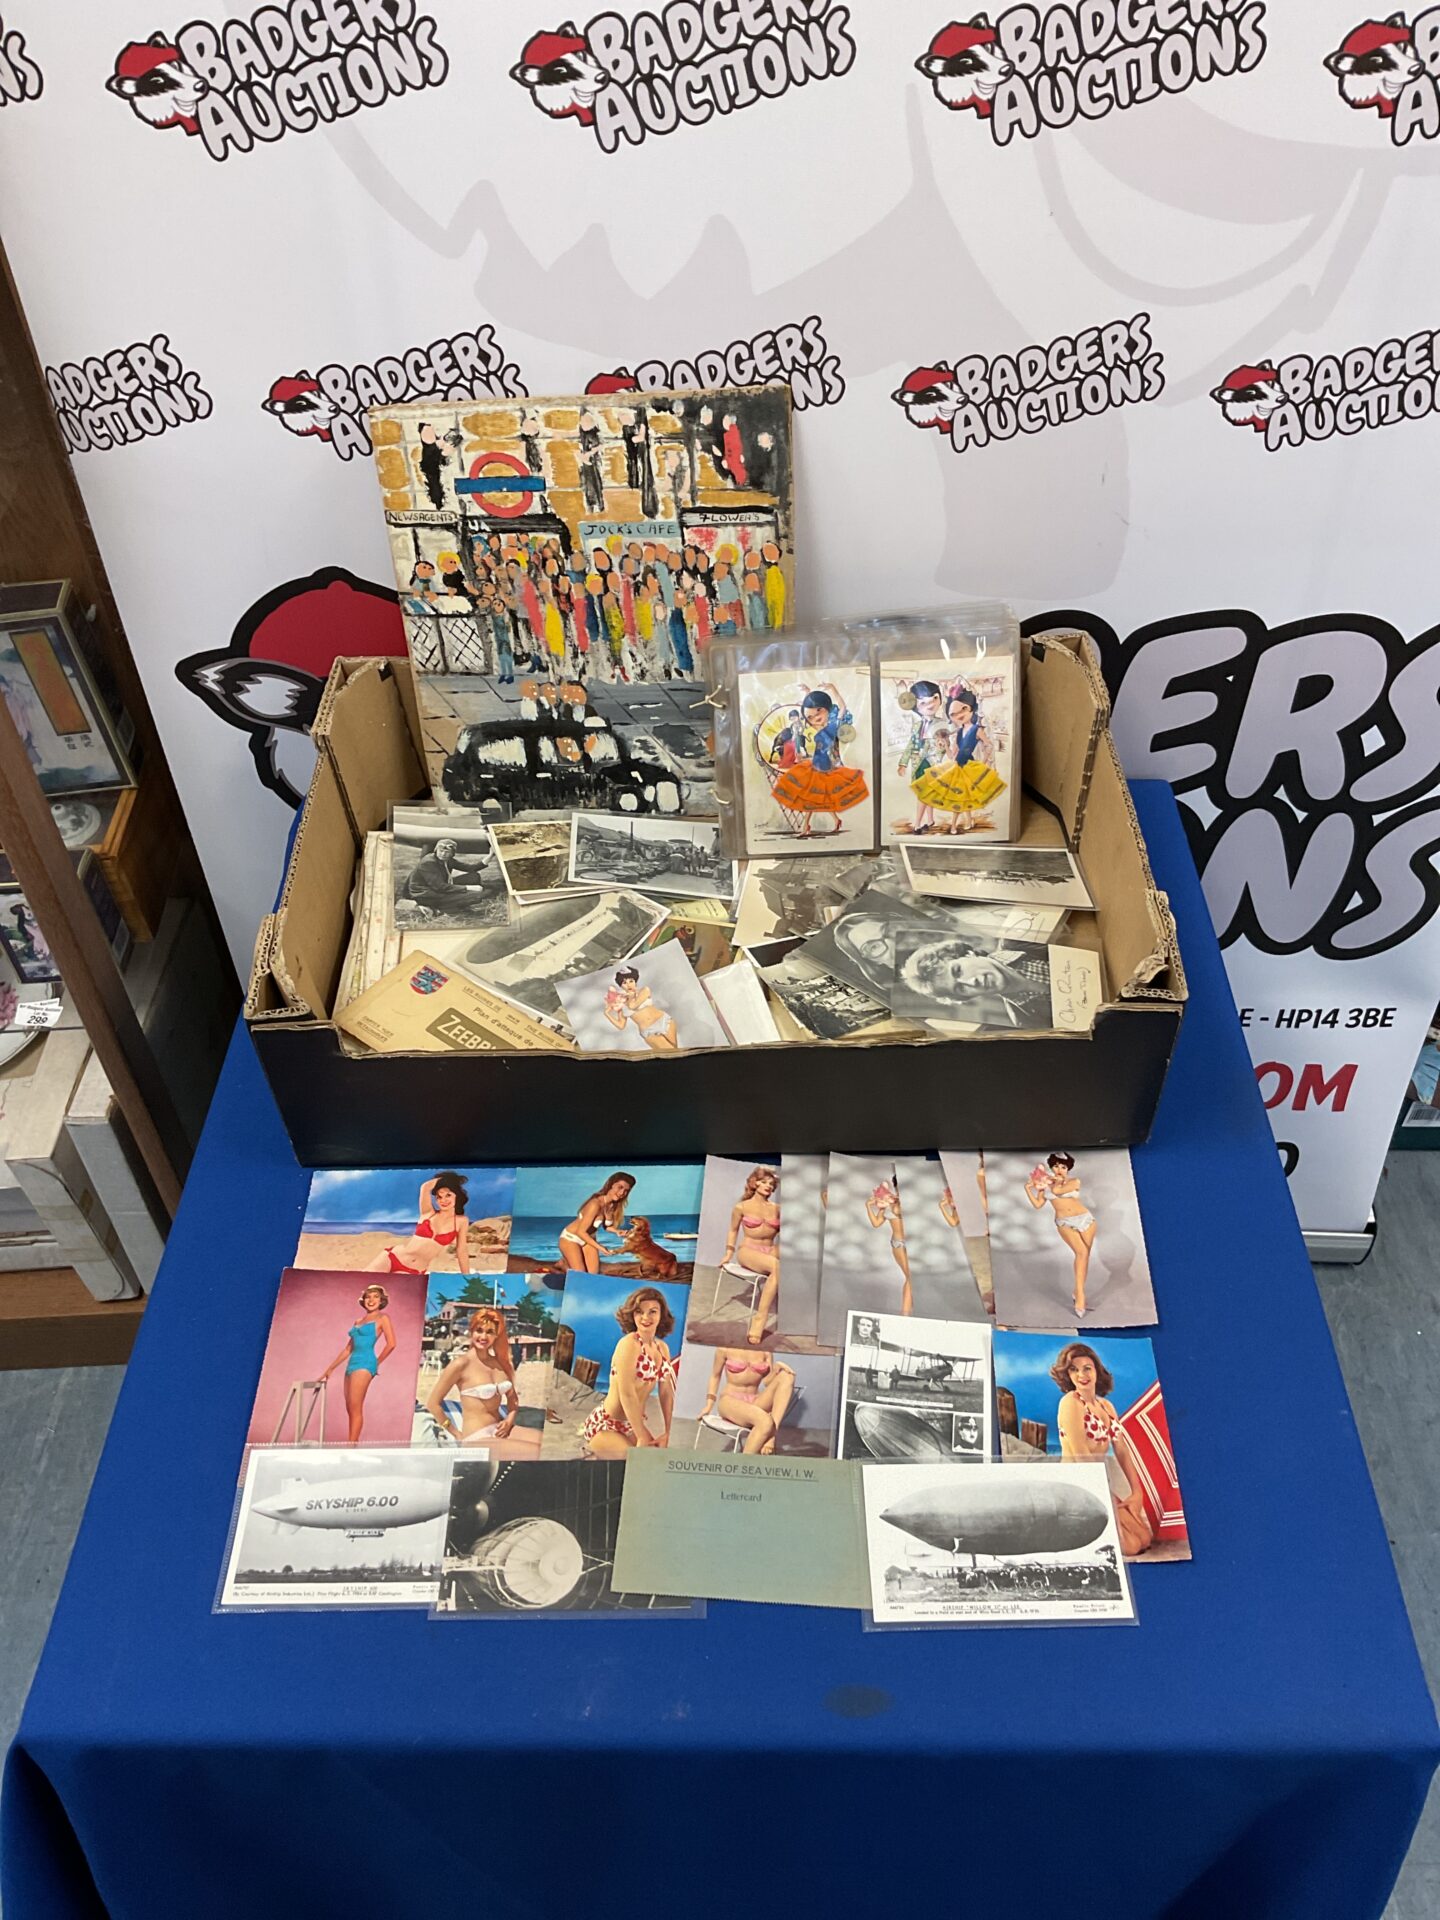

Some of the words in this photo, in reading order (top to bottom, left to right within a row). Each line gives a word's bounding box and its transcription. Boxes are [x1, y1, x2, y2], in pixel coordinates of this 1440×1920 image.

[197, 15, 449, 161] AUCTIONS
[594, 5, 856, 154] AUCTIONS
[990, 1, 1267, 146] AUCTIONS
[316, 324, 504, 414] BADGERS
[634, 315, 827, 392] BADGERS
[954, 312, 1152, 405] BADGERS
[1277, 329, 1440, 405] BADGE
[57, 371, 213, 454] UCTIONS
[950, 352, 1165, 453] AUCTIONS
[1265, 375, 1440, 452] AUCTIO
[388, 511, 453, 522] NEWSAGENTS
[637, 524, 676, 535] CAFE
[27, 1016, 48, 1024] 299
[473, 1006, 490, 1019] Plan
[1275, 1008, 1340, 1028] HP14
[1345, 1008, 1397, 1028] 3BE
[305, 1497, 363, 1511] SKYSHIP
[668, 1460, 722, 1473] SOUVENIR
[724, 1464, 739, 1474] OF
[741, 1466, 762, 1475] SEA
[720, 1491, 763, 1502] Lettercard
